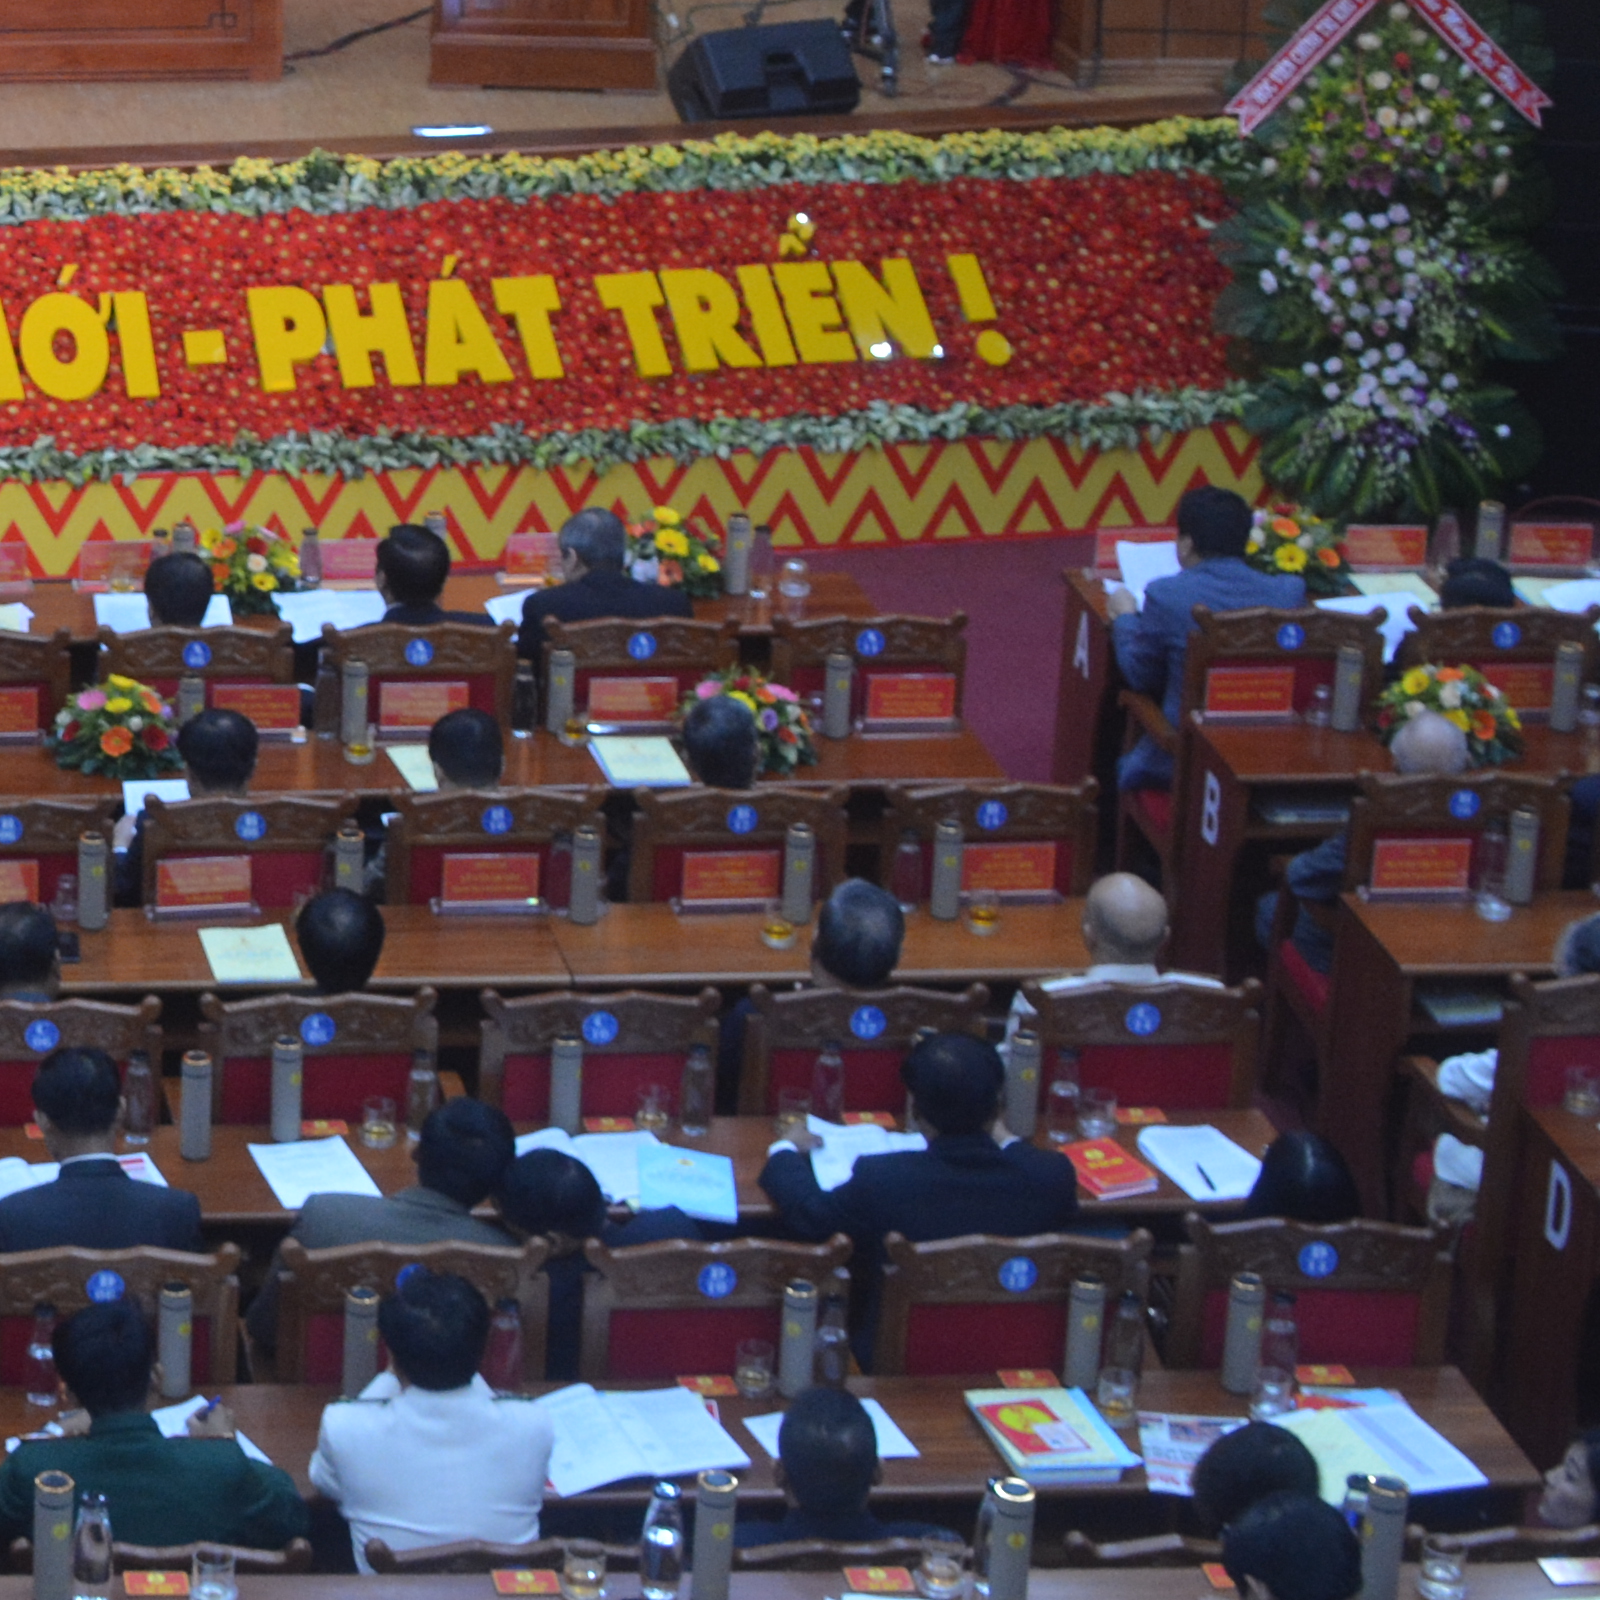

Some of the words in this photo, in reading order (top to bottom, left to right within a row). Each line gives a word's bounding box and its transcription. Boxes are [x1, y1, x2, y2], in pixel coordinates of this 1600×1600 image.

[246, 255, 562, 392] PHÁT
[595, 215, 938, 376] TRIỂN
[1074, 611, 1090, 679] A
[1201, 770, 1221, 844] B
[1545, 1160, 1572, 1249] D
